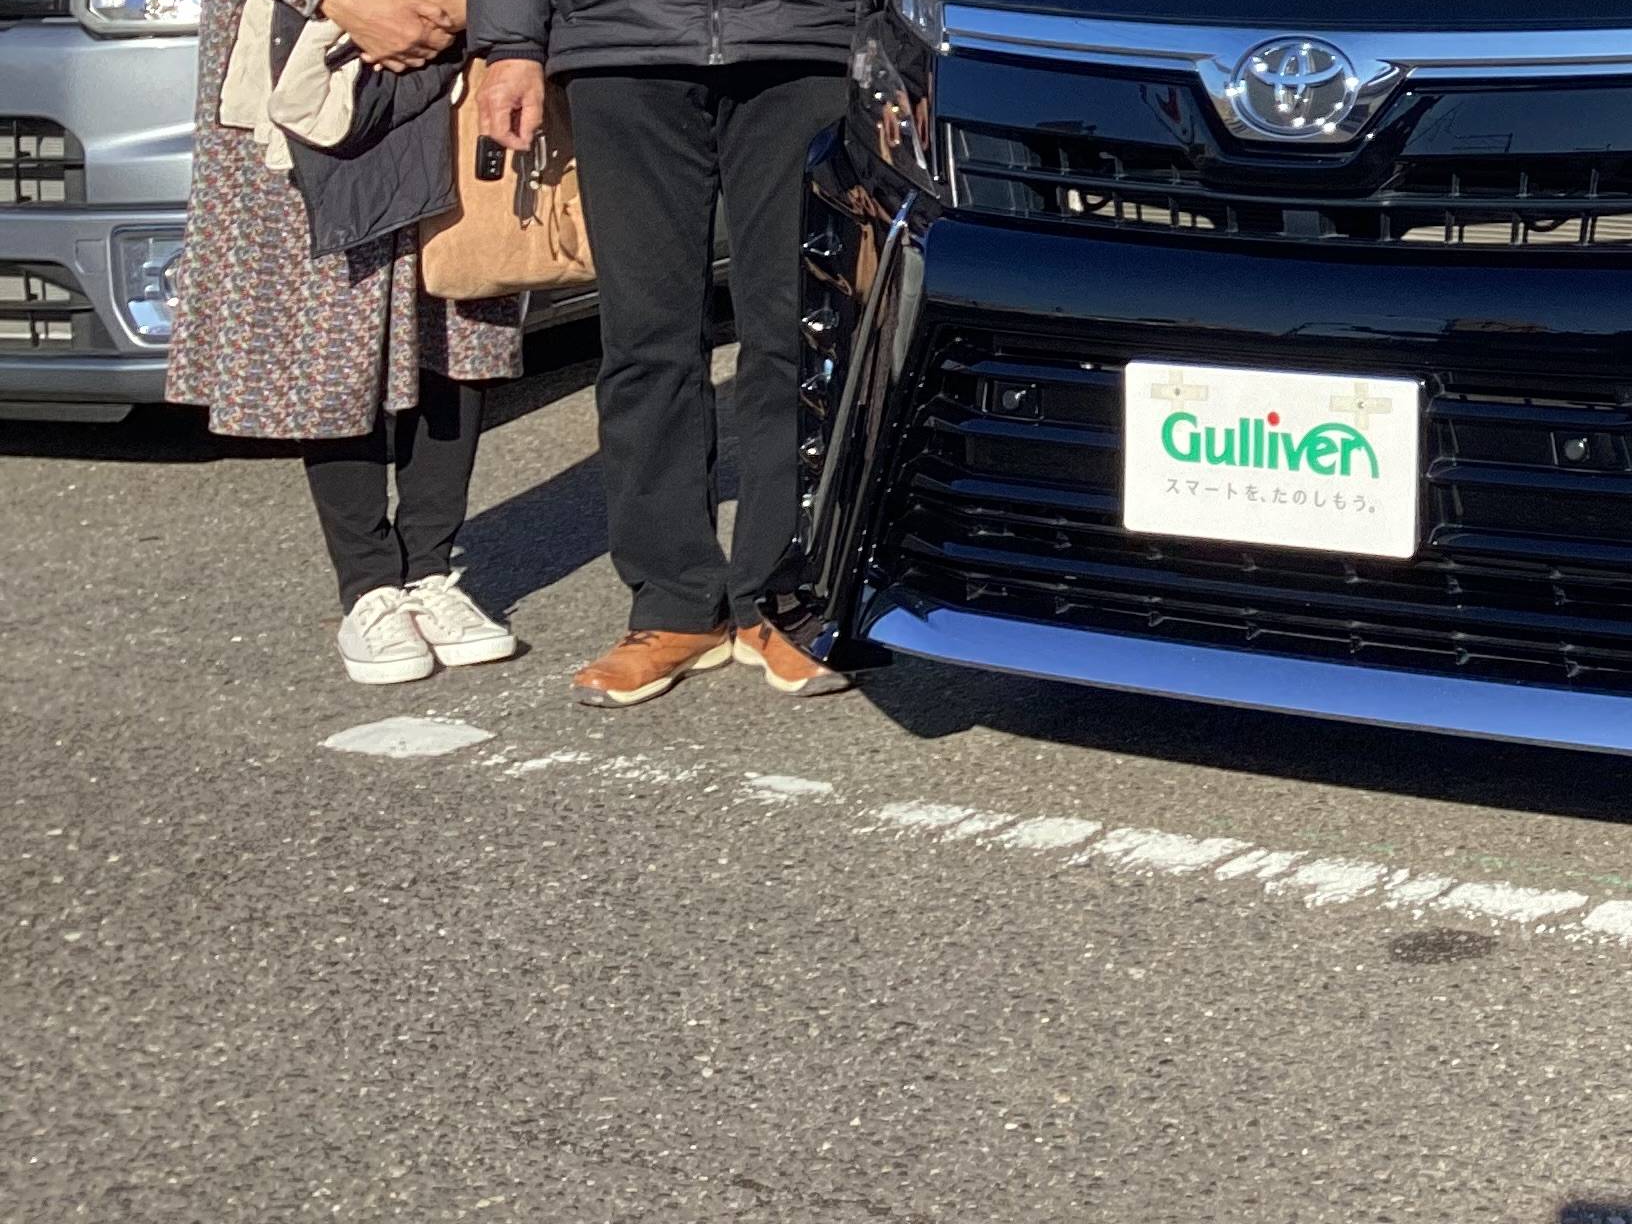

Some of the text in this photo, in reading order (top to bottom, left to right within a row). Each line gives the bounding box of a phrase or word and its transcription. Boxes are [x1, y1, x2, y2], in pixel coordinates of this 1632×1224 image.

[1161, 411, 1380, 479] Gulliver
[1165, 478, 1376, 514] スマートを、たのしもう。
